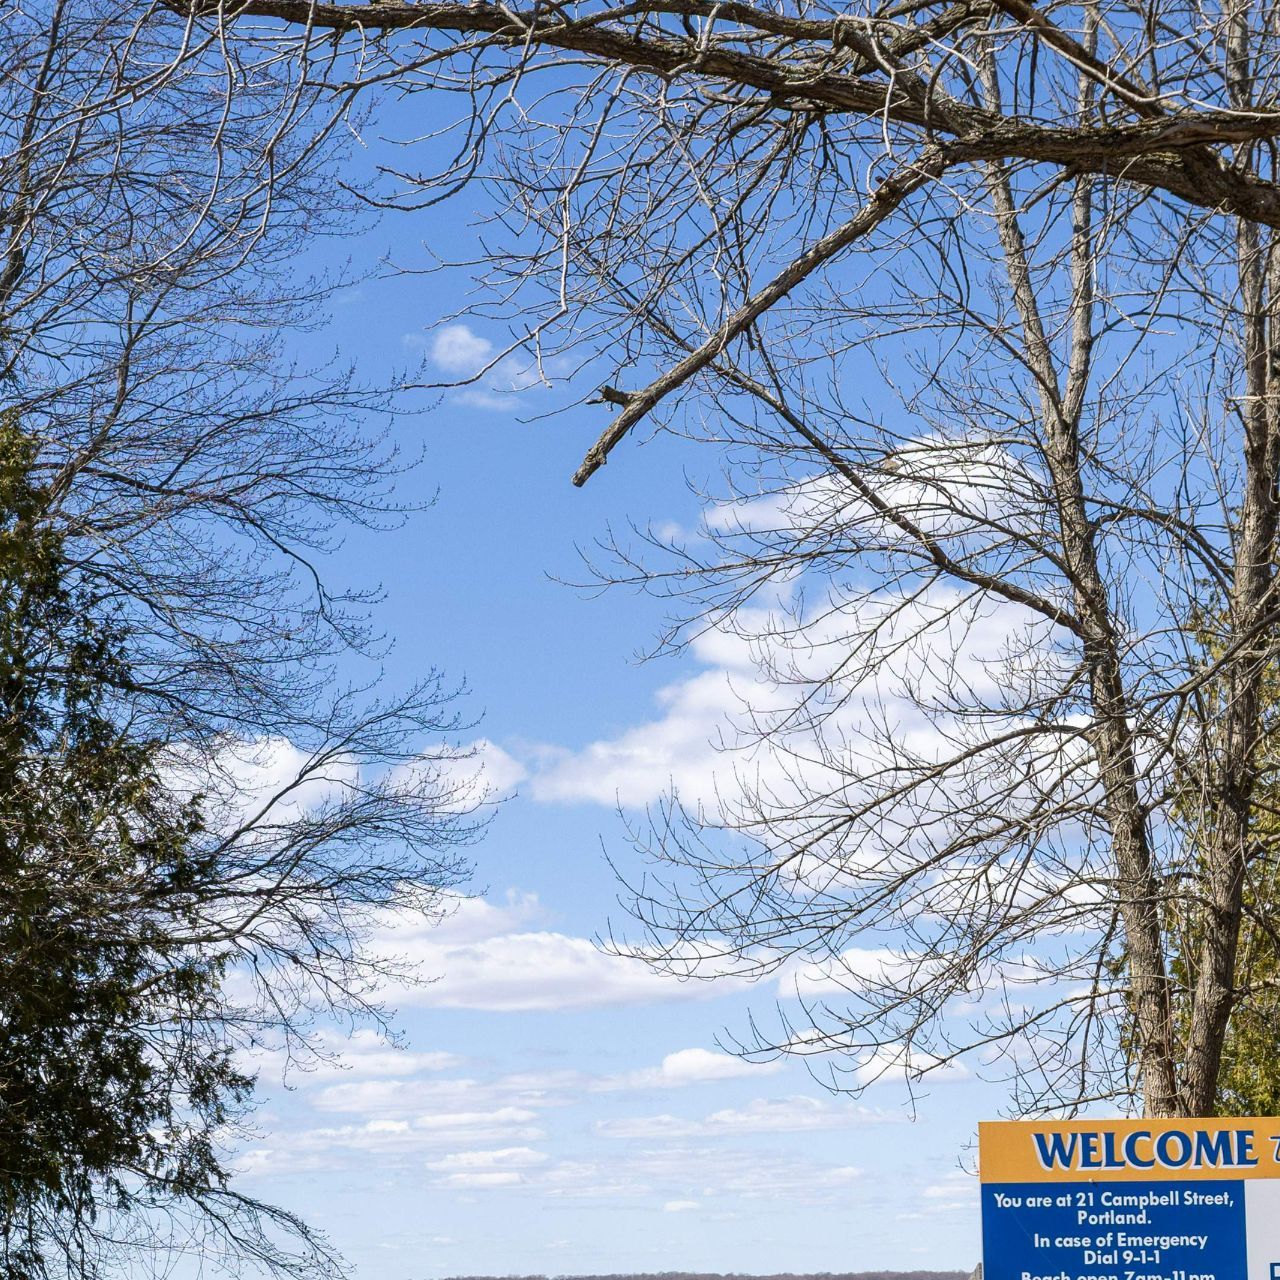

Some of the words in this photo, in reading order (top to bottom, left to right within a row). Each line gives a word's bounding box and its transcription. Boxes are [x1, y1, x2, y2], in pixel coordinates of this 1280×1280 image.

[1031, 1130, 1259, 1171] WELCOME
[994, 1194, 1021, 1207] You
[1026, 1198, 1052, 1207] are
[1056, 1194, 1072, 1206] at
[1076, 1192, 1093, 1206] 21
[1101, 1191, 1179, 1209] Campbell
[1184, 1191, 1233, 1207] Street,
[1078, 1210, 1151, 1224] Portland.
[1035, 1234, 1050, 1247] In
[1055, 1237, 1091, 1247] case
[1096, 1233, 1113, 1246] of
[1118, 1233, 1208, 1249] Emergency
[1084, 1250, 1118, 1264] Dial
[1123, 1250, 1159, 1264] 9-1-1
